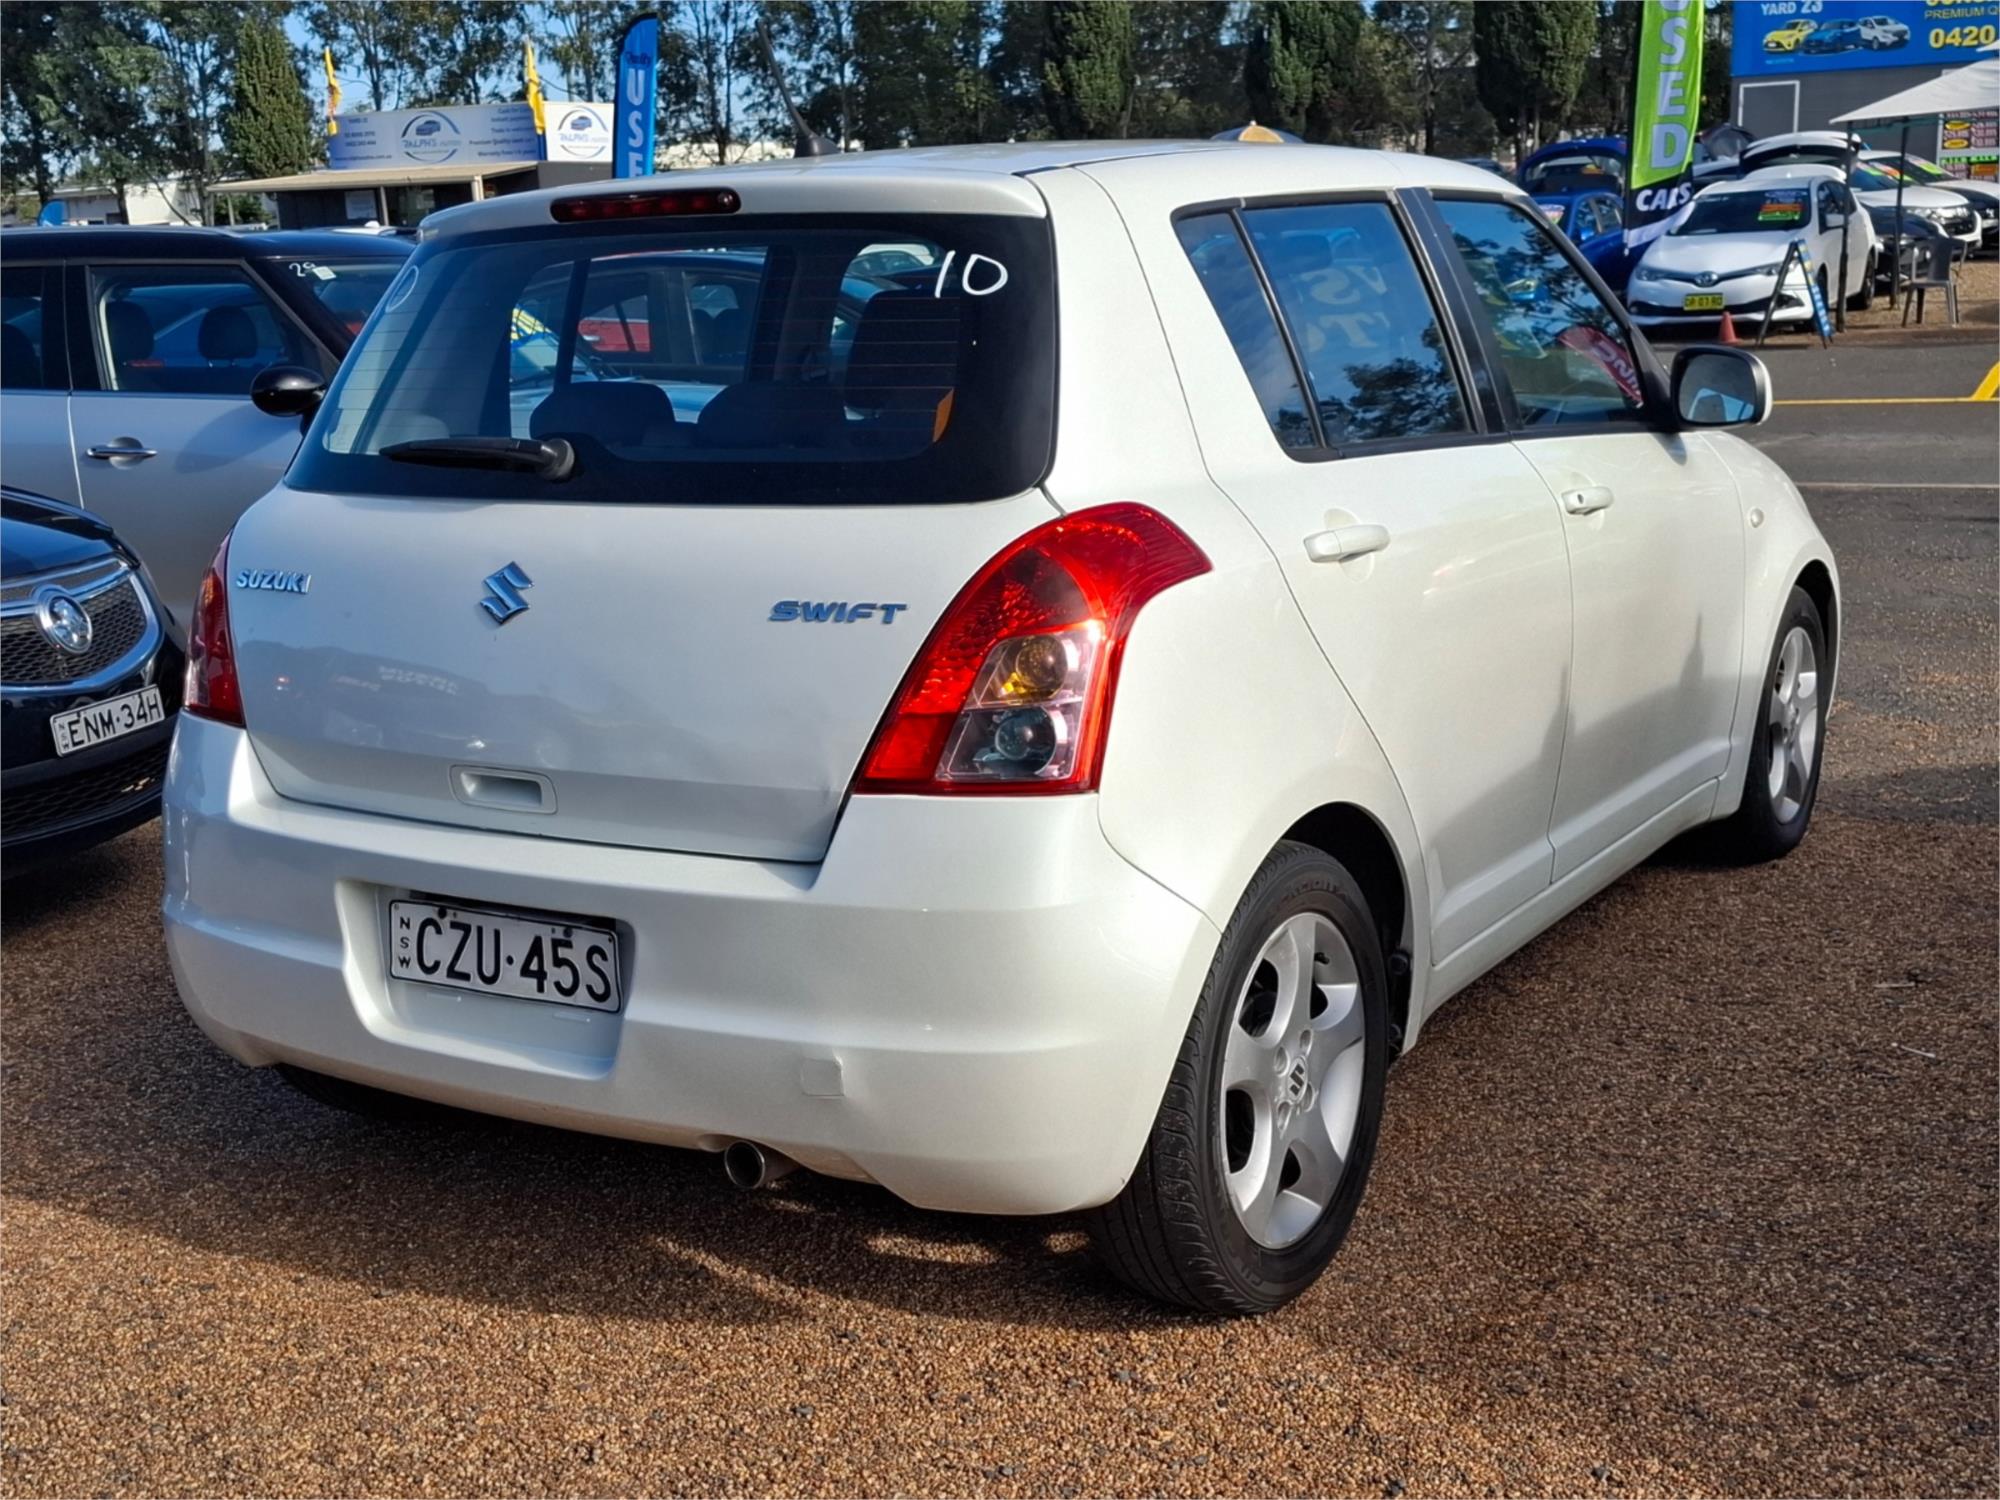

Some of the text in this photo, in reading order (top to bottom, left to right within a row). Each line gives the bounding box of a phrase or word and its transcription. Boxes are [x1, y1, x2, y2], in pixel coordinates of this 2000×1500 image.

[1761, 0, 1823, 16] YARD 23
[1924, 6, 1985, 20] PREMIUM
[1929, 24, 1996, 49] 0420
[1651, 0, 1690, 169] SED
[934, 249, 1008, 296] 10
[236, 569, 312, 593] SUZUKI
[768, 600, 907, 624] SWIFT
[398, 917, 411, 970] NSW
